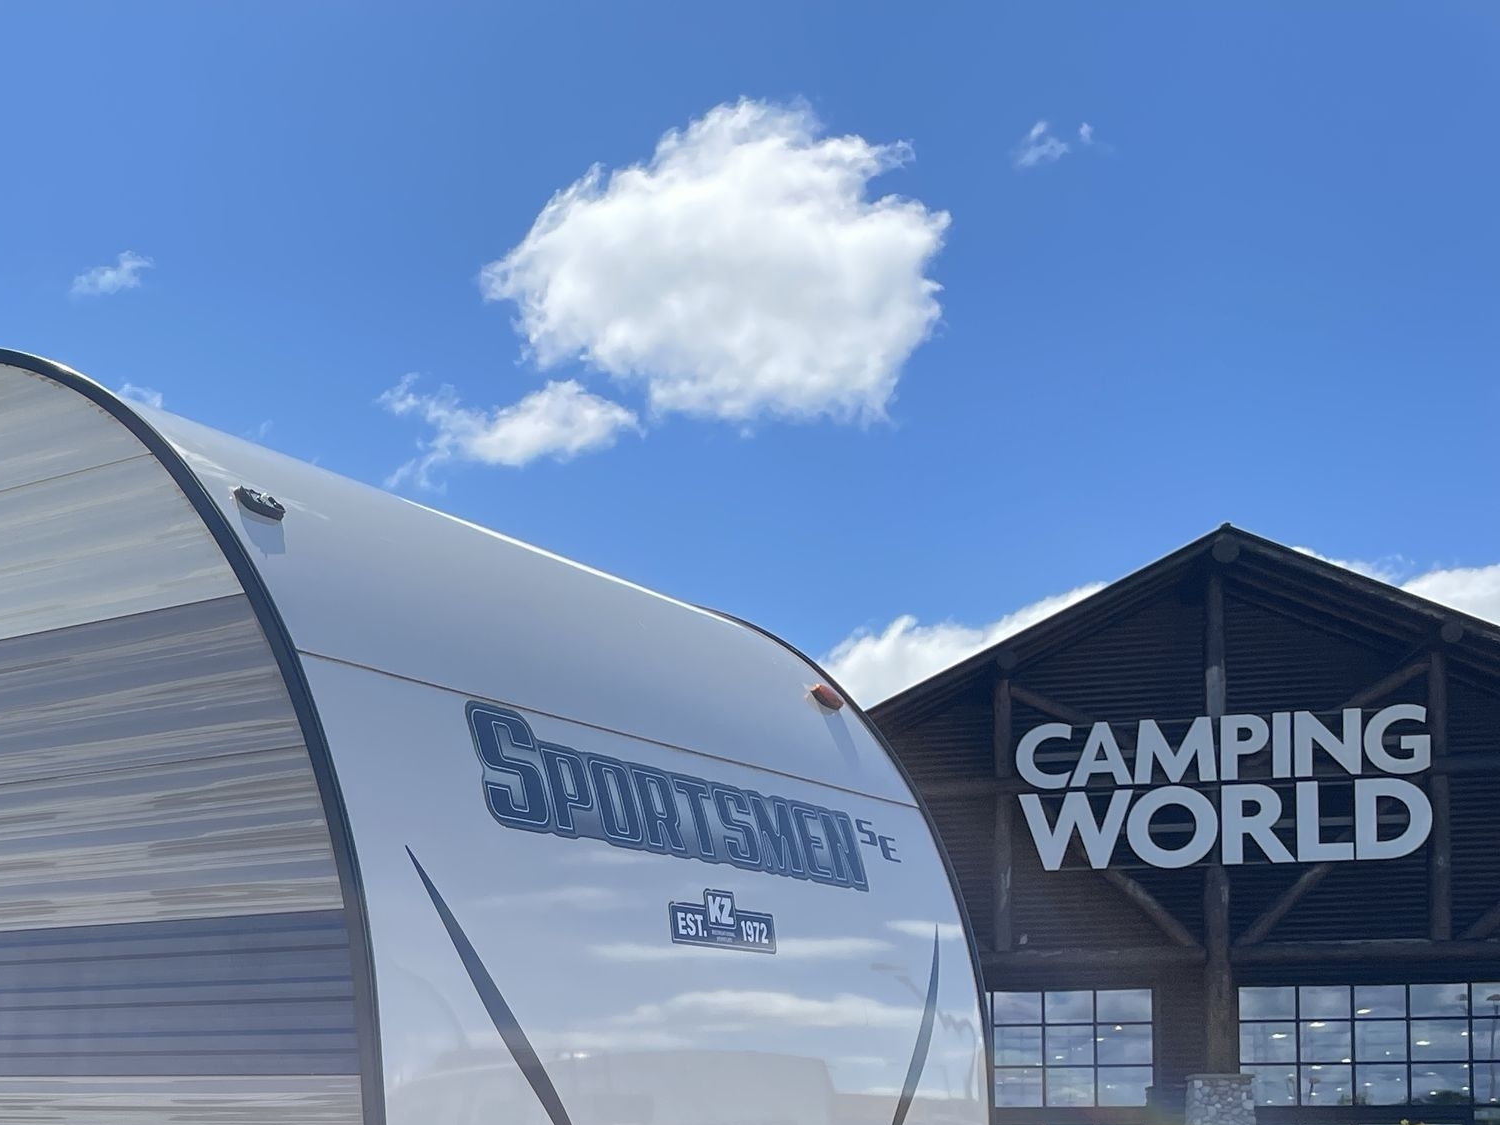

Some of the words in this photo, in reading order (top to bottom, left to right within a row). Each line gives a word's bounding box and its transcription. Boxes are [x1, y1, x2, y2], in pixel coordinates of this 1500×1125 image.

[1015, 703, 1431, 790] CAMPING
[466, 701, 868, 891] SPORTSMEN
[855, 818, 902, 863] SE
[1017, 777, 1433, 871] WORLD
[676, 911, 707, 937] EST.
[740, 920, 769, 944] 1972
[707, 895, 734, 925] KZ
